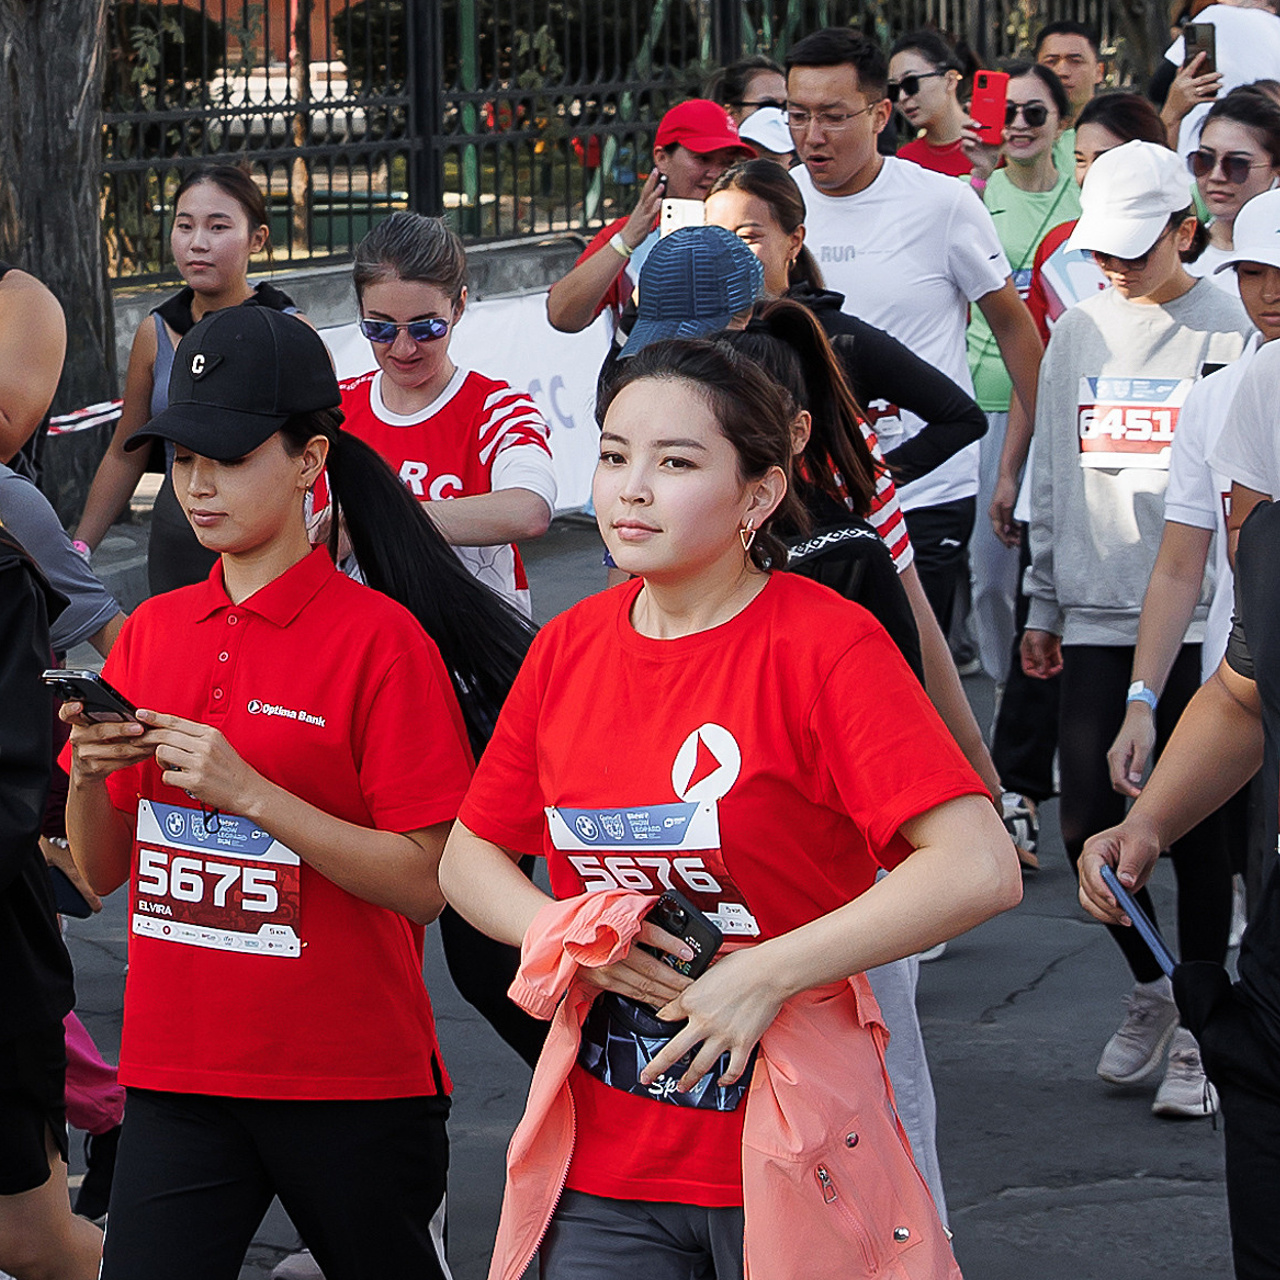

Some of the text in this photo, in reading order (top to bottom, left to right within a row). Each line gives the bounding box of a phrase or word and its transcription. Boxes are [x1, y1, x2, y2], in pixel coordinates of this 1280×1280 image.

[191, 354, 206, 374] C
[1079, 407, 1175, 442] 6451
[262, 703, 326, 727] Optima Bank
[138, 848, 279, 913] 5675
[567, 856, 723, 893] 5676
[138, 899, 173, 917] ELVIRA
